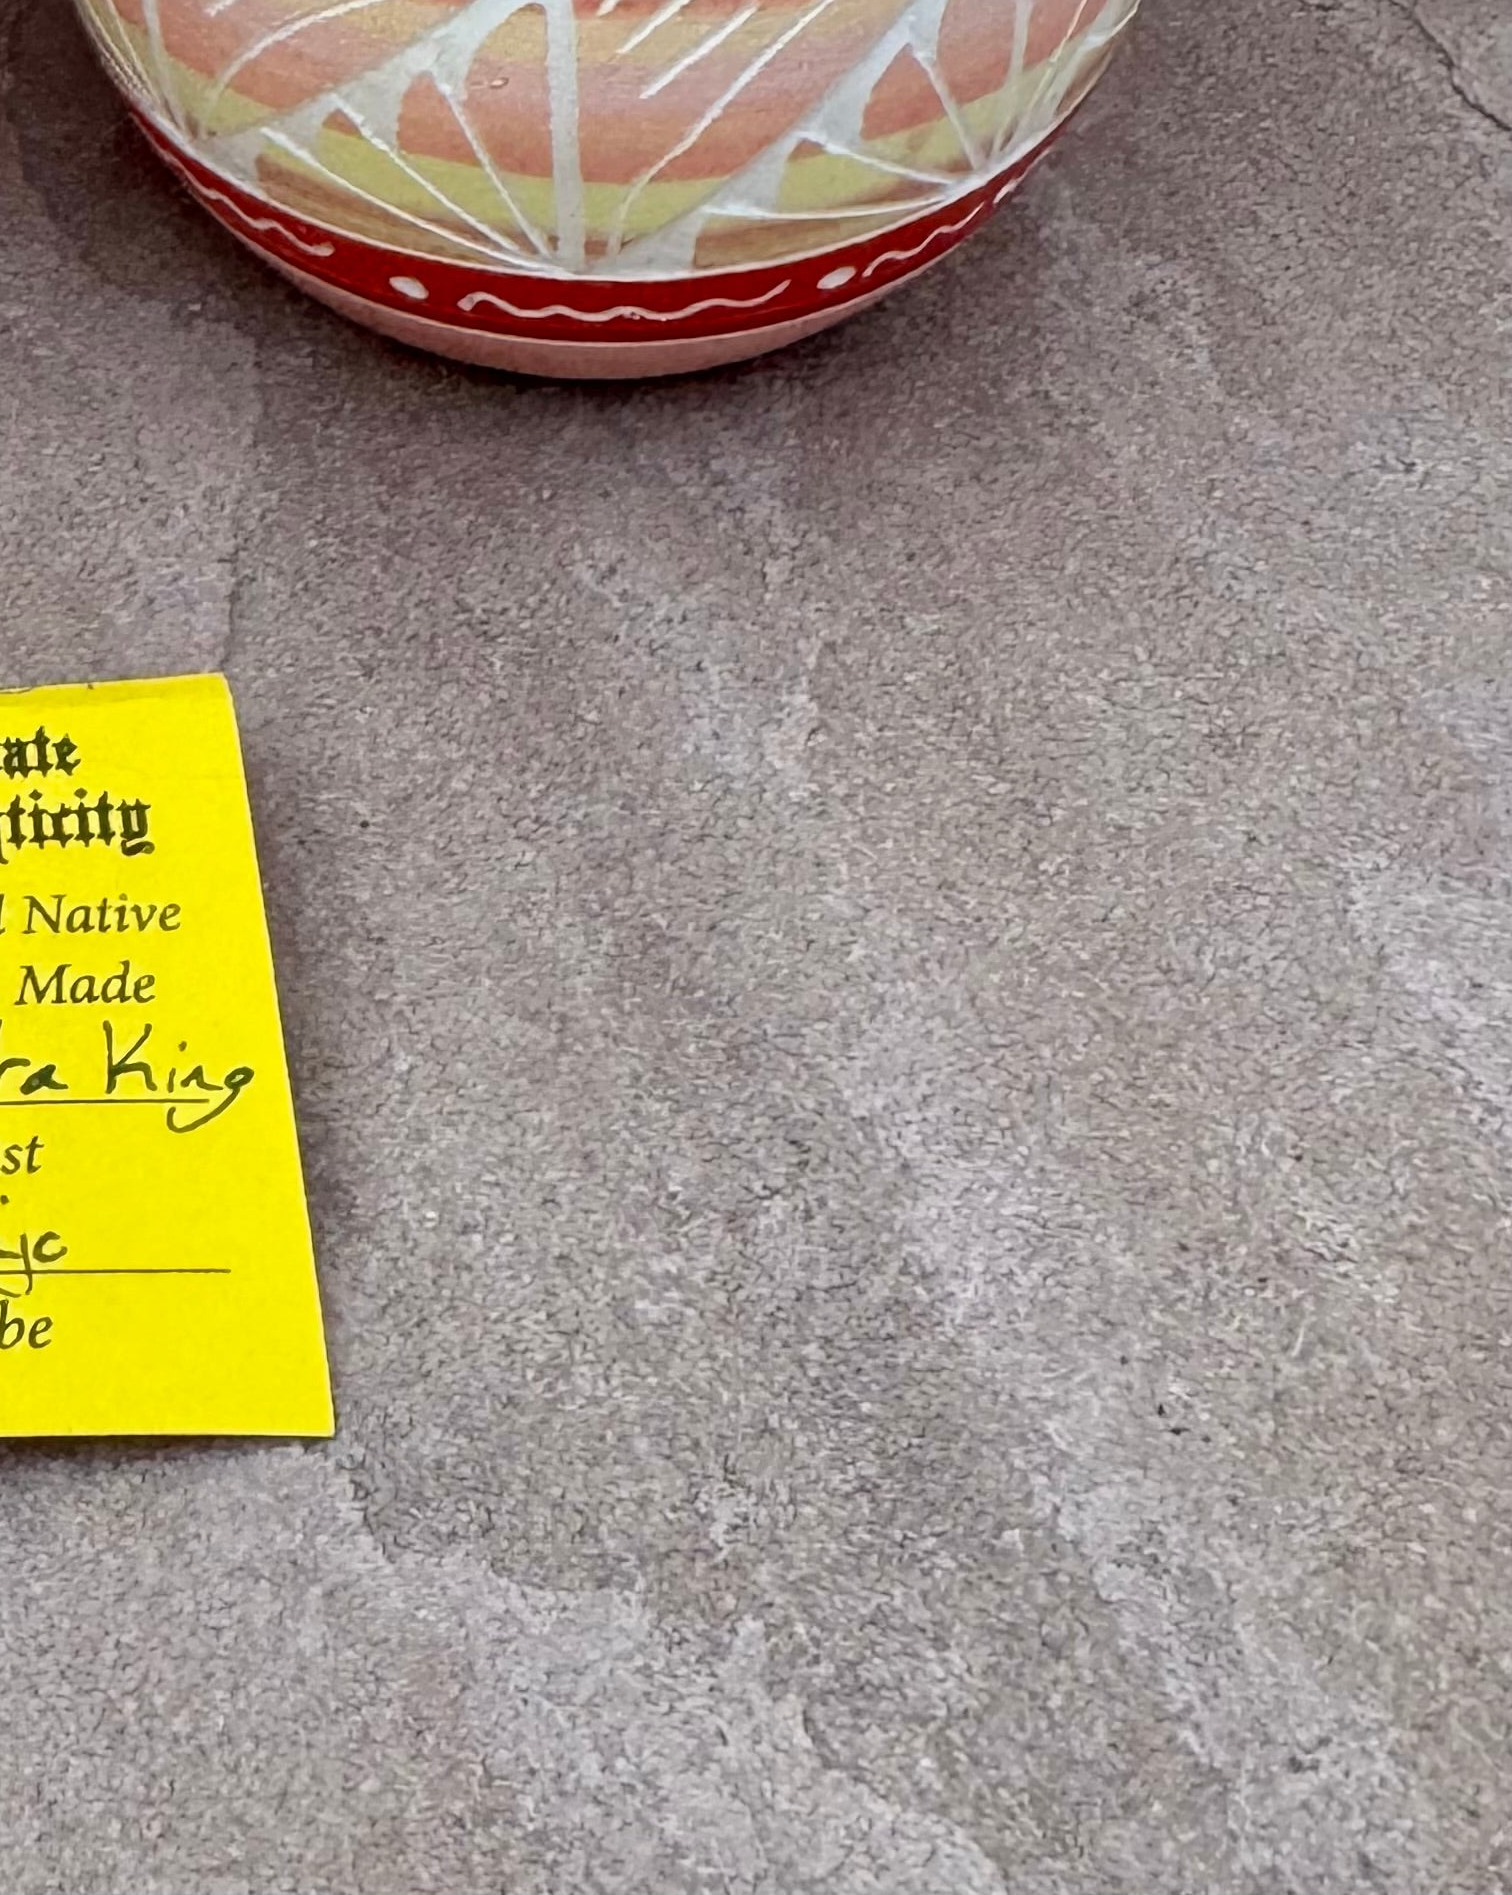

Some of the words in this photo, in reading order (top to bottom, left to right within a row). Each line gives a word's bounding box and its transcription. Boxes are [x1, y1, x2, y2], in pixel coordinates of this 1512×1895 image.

[22, 892, 183, 936] Native
[14, 959, 156, 1006] Made
[102, 1019, 256, 1134] King
